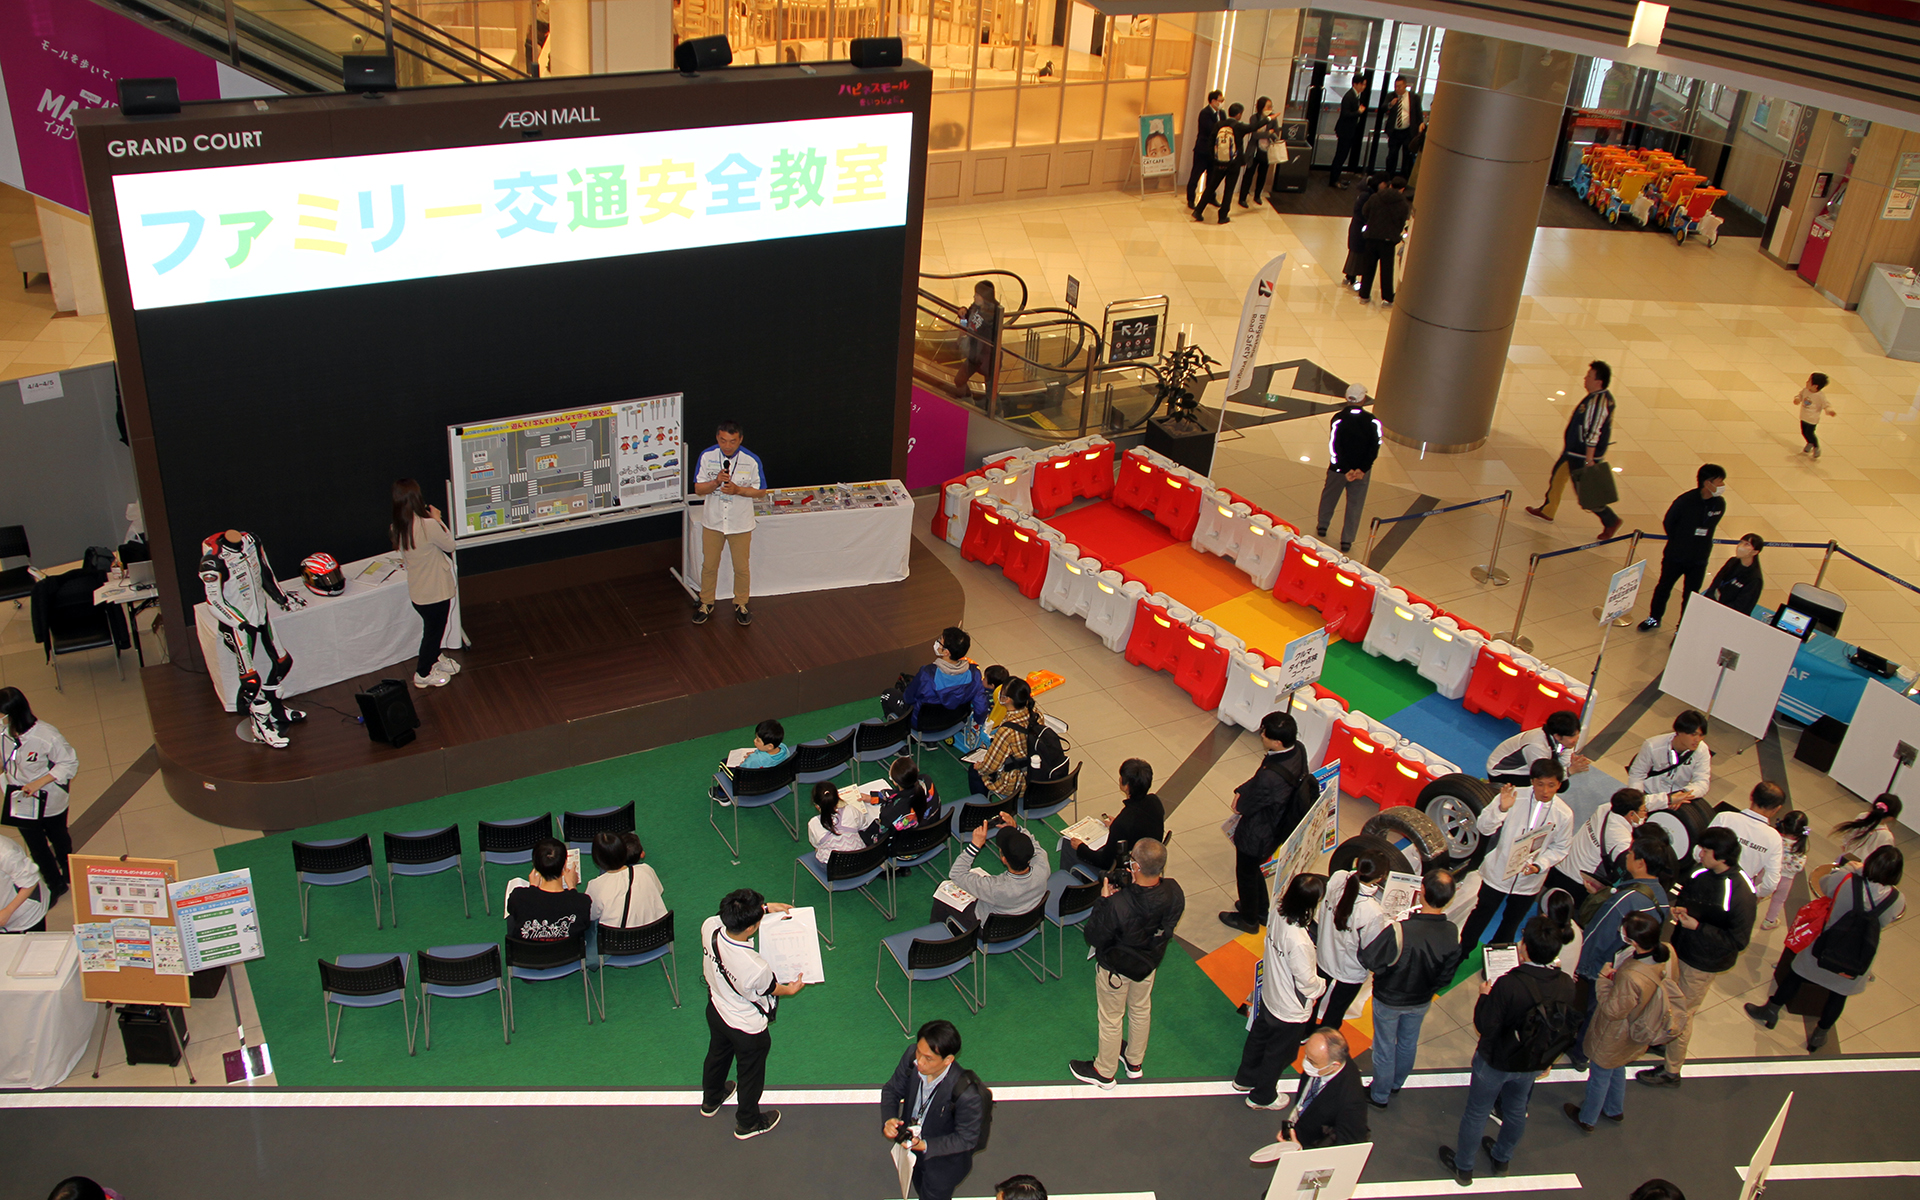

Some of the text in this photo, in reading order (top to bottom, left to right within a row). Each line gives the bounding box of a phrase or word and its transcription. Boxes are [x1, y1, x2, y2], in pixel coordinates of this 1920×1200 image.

[551, 106, 600, 125] MALL
[108, 130, 263, 157] GRAND COURT
[140, 143, 889, 276] ファミリー交通安全教室
[1134, 322, 1149, 336] 2F
[1248, 313, 1257, 333] Road
[1242, 333, 1254, 358] Safety
[1788, 667, 1811, 681] AF
[1749, 842, 1768, 853] SAFETY
